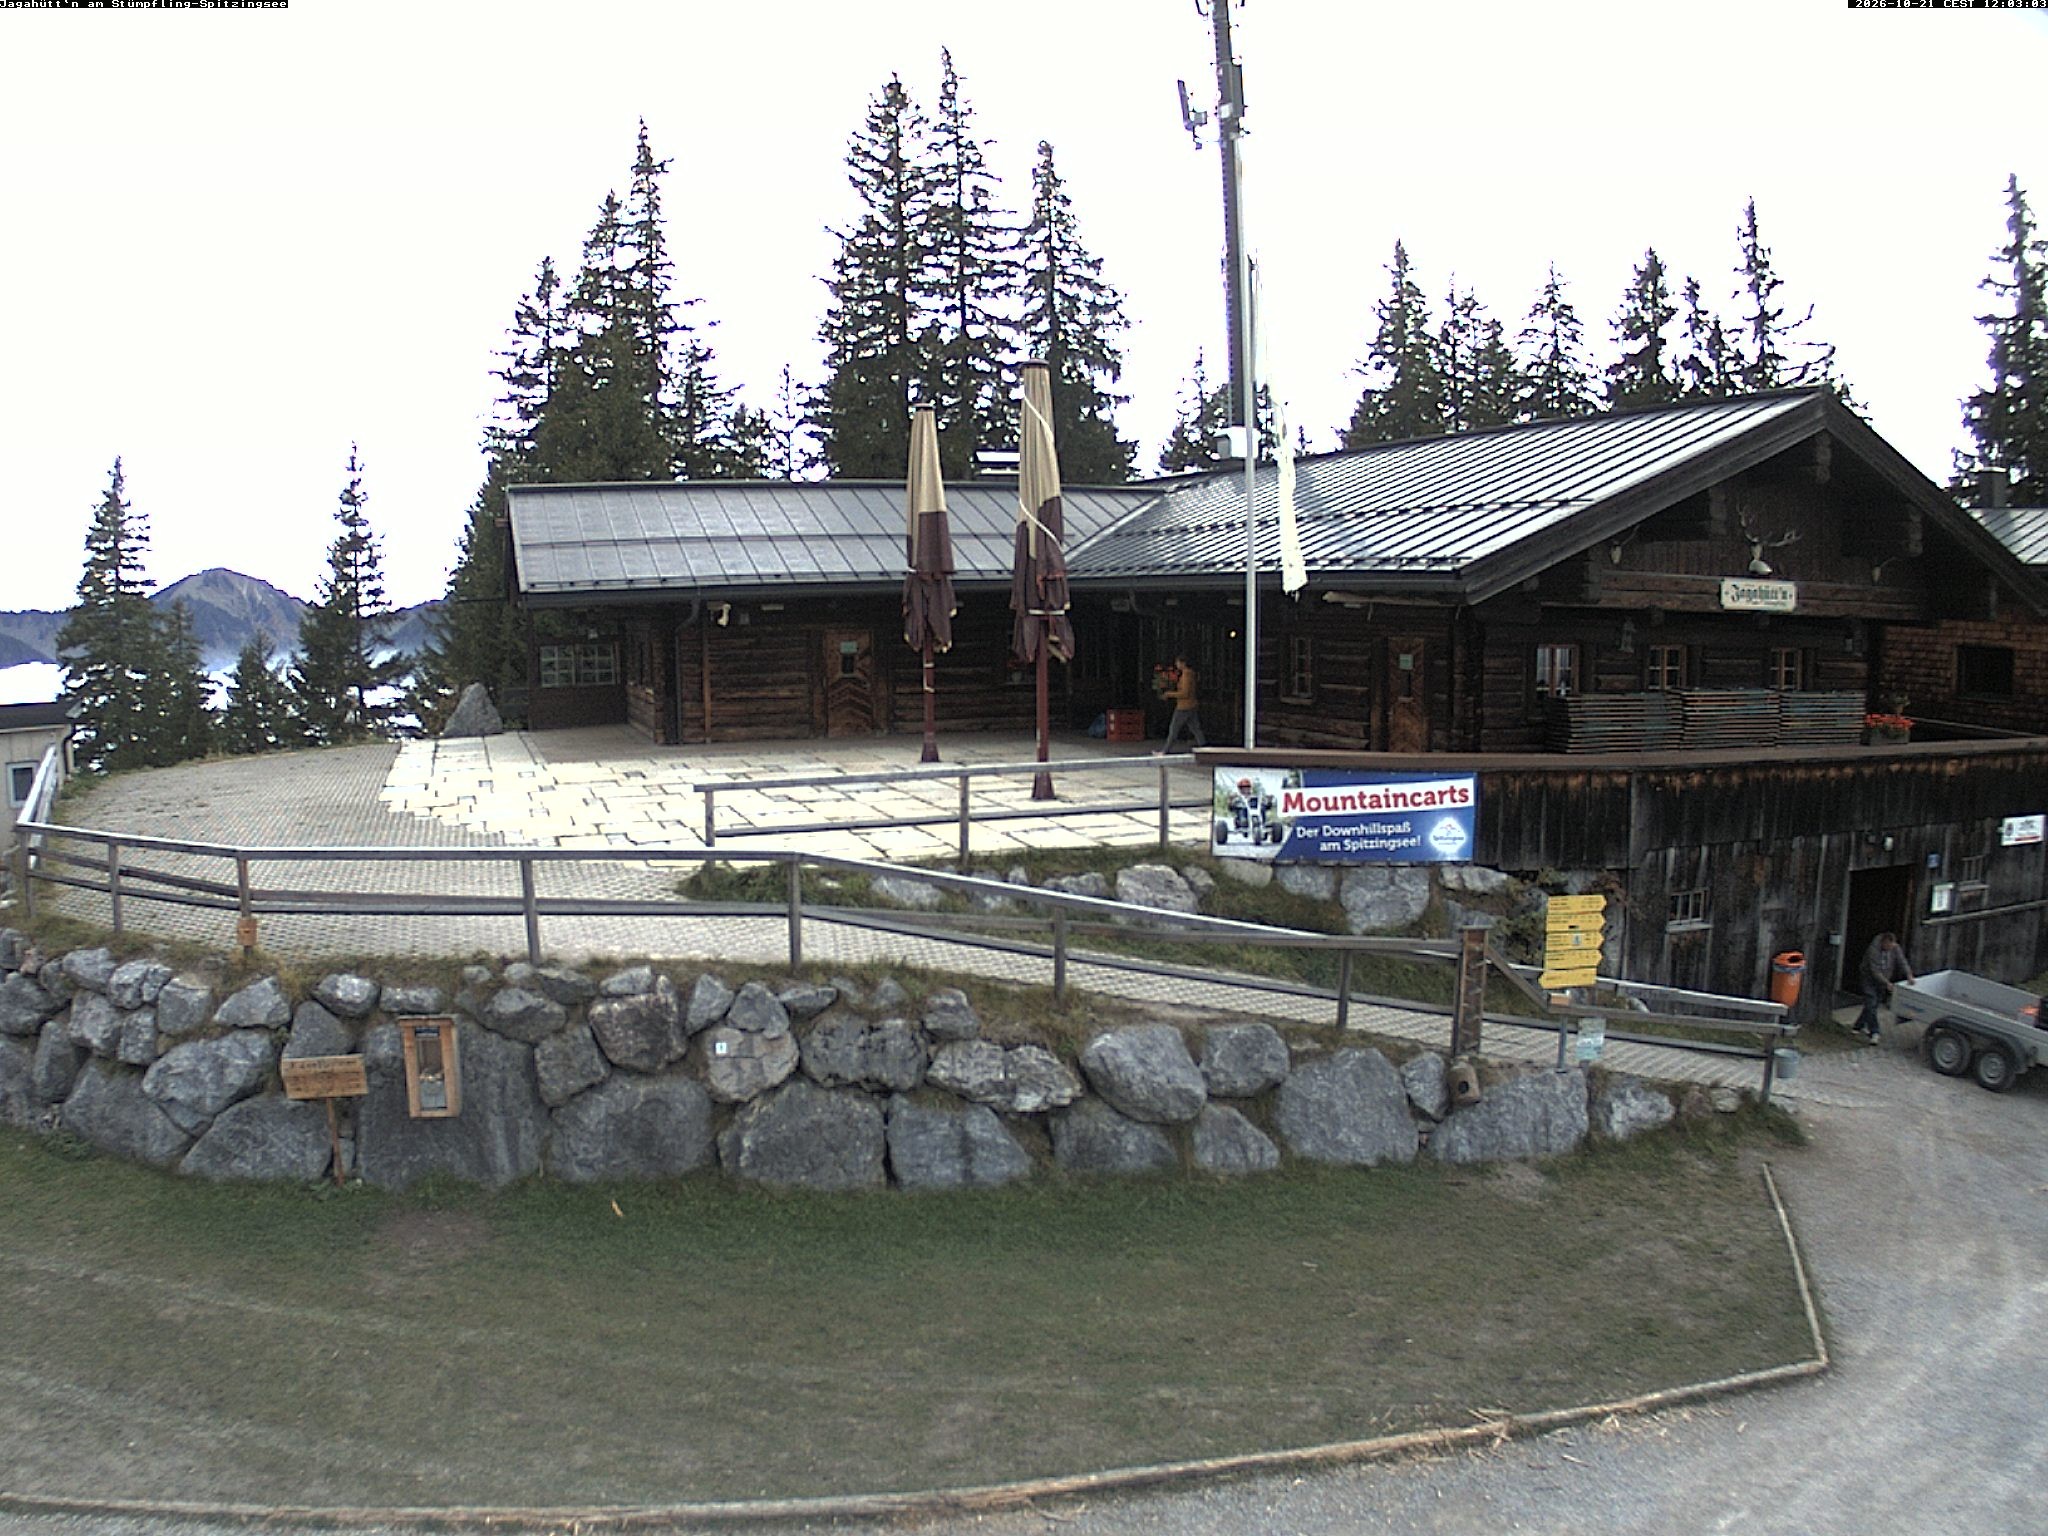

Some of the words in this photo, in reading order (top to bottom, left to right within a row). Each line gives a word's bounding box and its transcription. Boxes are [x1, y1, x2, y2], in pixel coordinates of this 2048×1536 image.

[1282, 785, 1469, 813] Mountaincarts
[1296, 826, 1318, 838] Der
[1322, 821, 1411, 837] Downhillspaß
[1320, 840, 1341, 851] am
[1344, 835, 1421, 853] Spitzingsee!
